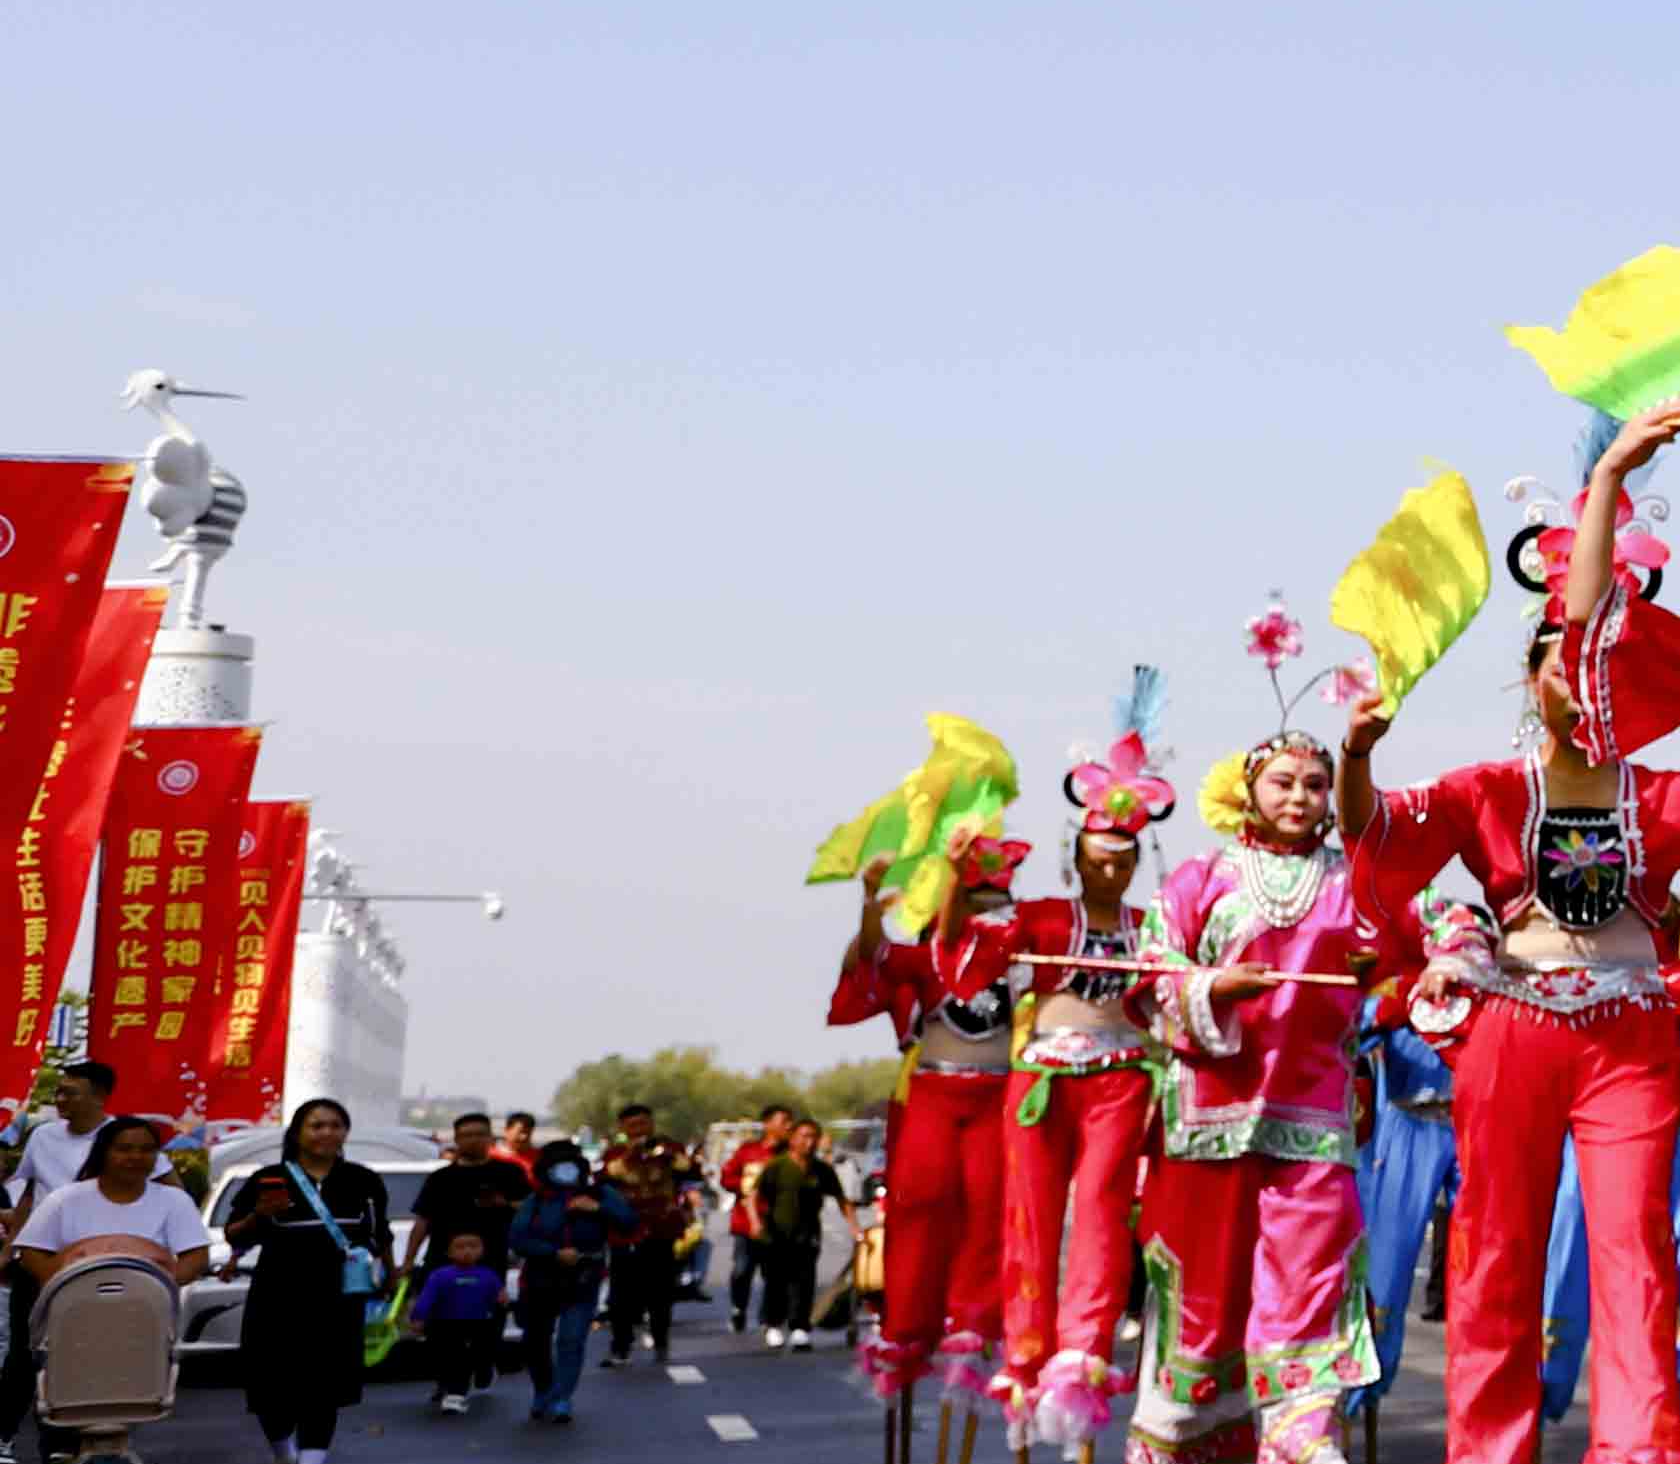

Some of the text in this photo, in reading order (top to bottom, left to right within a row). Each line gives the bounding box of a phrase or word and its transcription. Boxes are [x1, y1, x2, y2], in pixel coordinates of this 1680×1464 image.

[109, 828, 163, 1040] 保护文化遗产
[154, 828, 210, 1040] 守护精神家园
